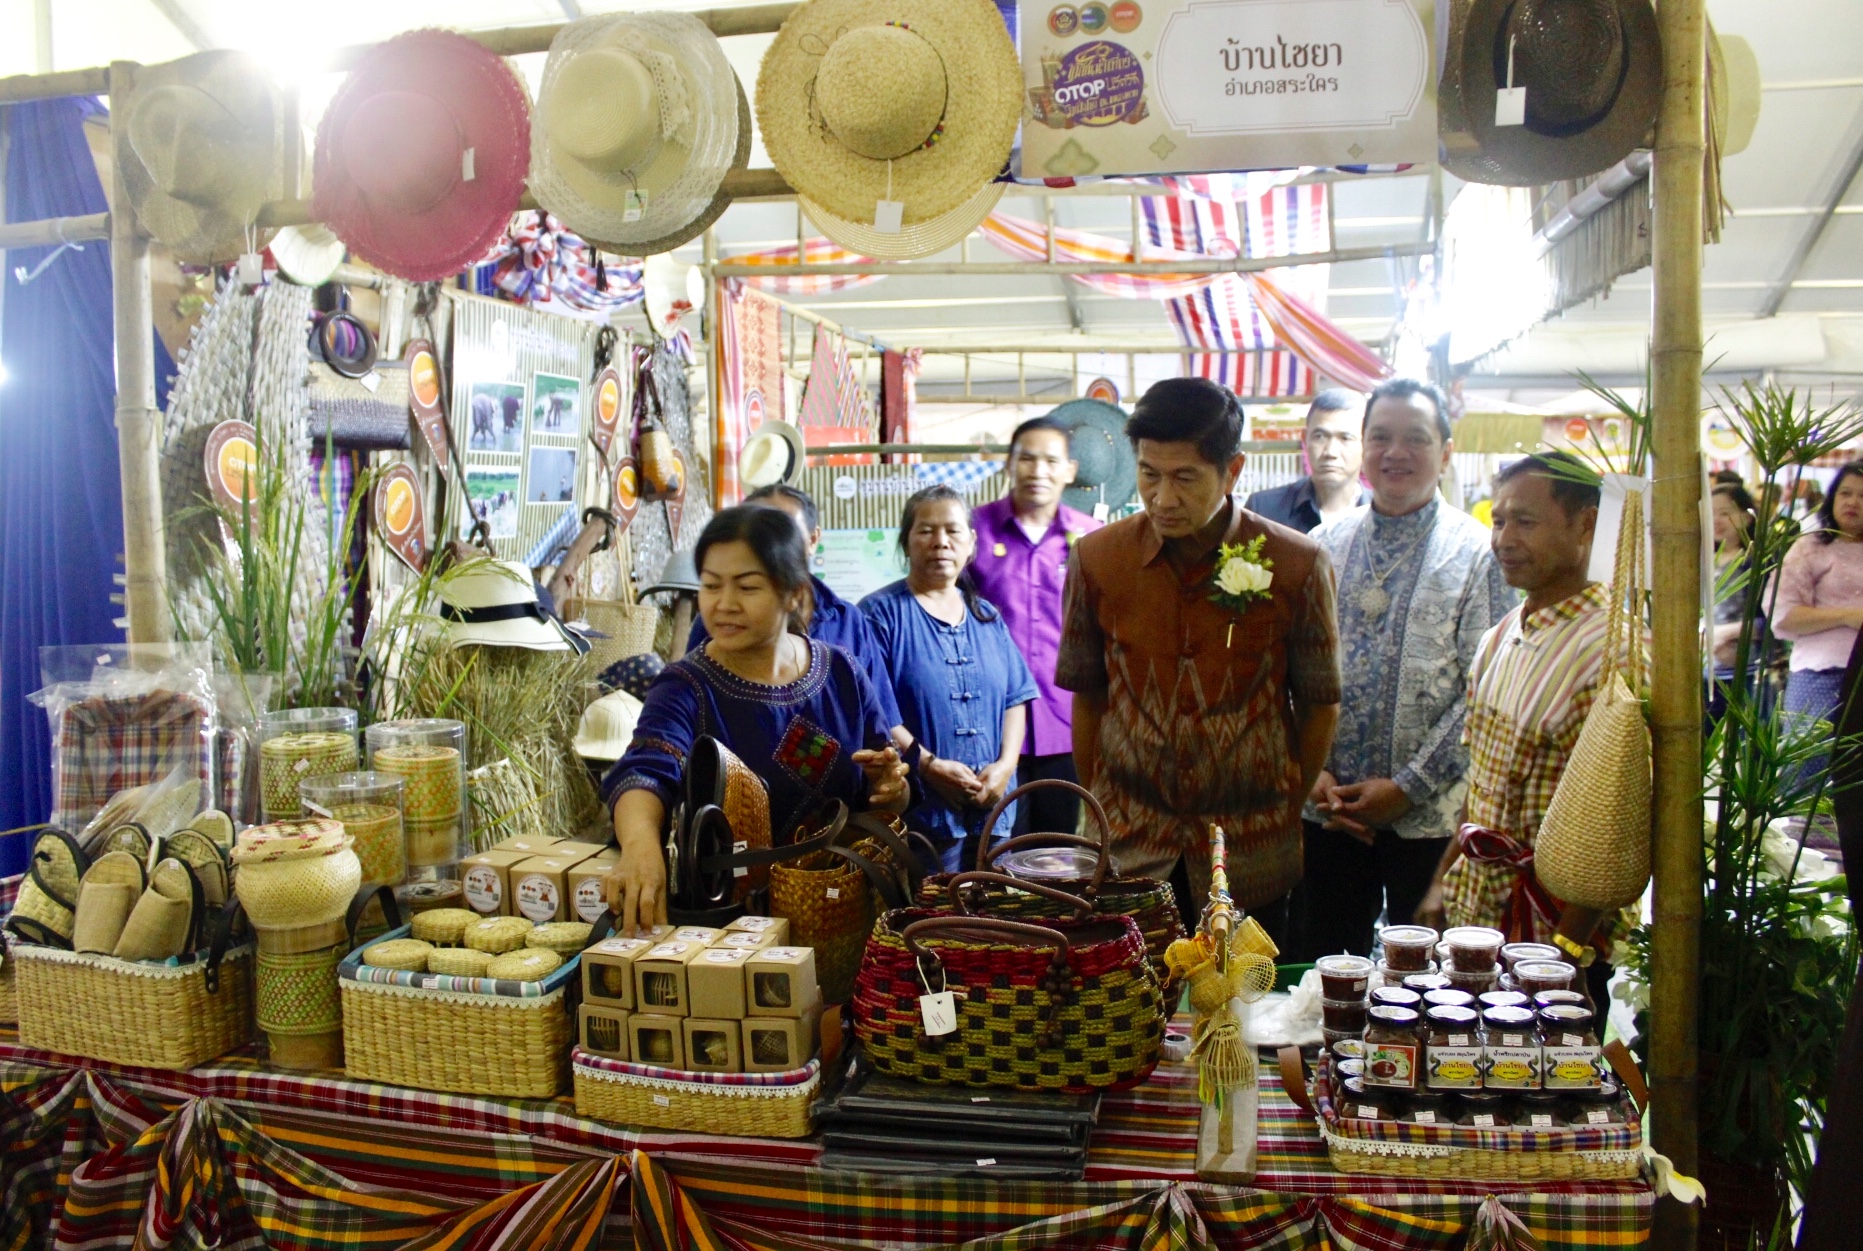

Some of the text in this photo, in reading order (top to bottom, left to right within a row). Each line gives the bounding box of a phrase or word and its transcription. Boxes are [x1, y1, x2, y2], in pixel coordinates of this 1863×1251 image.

[1219, 34, 1342, 71] บ้านไชยา
[1055, 79, 1105, 103] OTOP
[1225, 73, 1339, 96] อำเภอสระใคร
